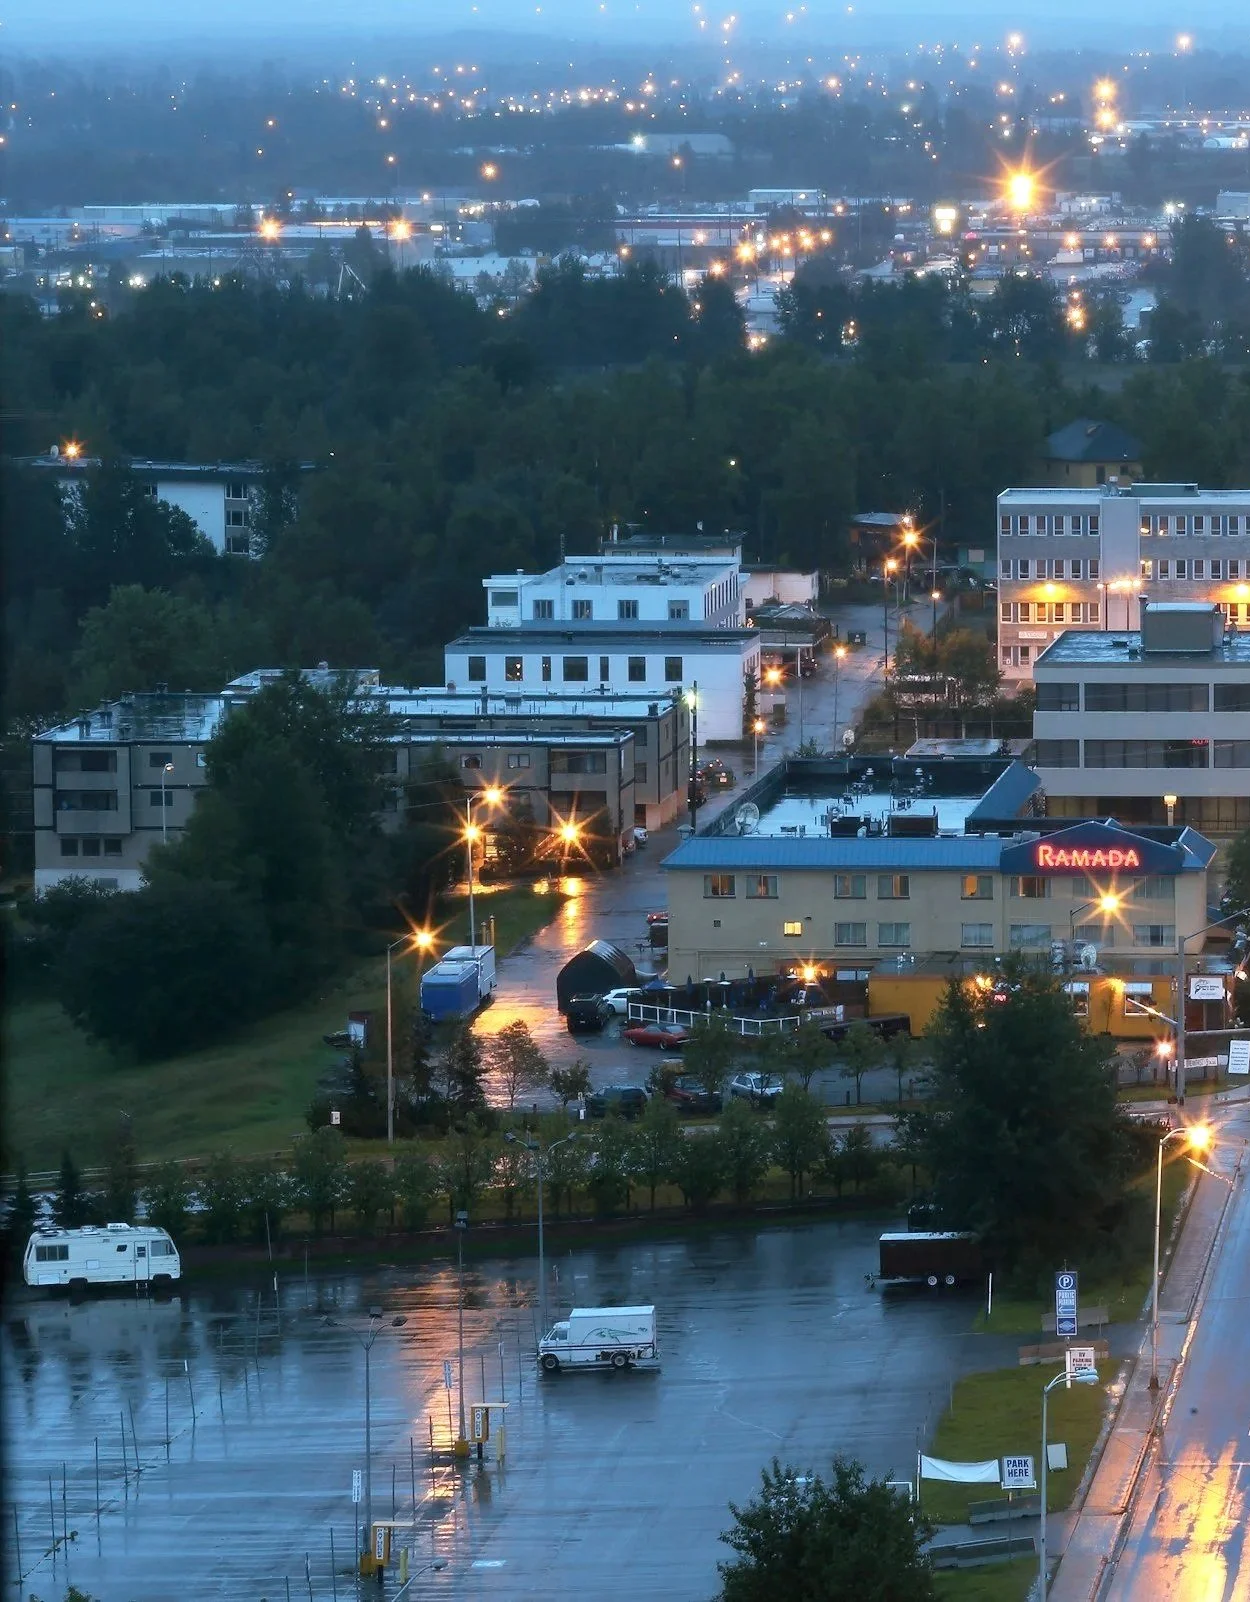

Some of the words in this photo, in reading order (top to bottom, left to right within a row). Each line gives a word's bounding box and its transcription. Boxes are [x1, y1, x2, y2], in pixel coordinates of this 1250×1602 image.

[1039, 845, 1139, 866] RAMADA
[1007, 1459, 1029, 1468] PARK
[1008, 1468, 1029, 1477] HERE
